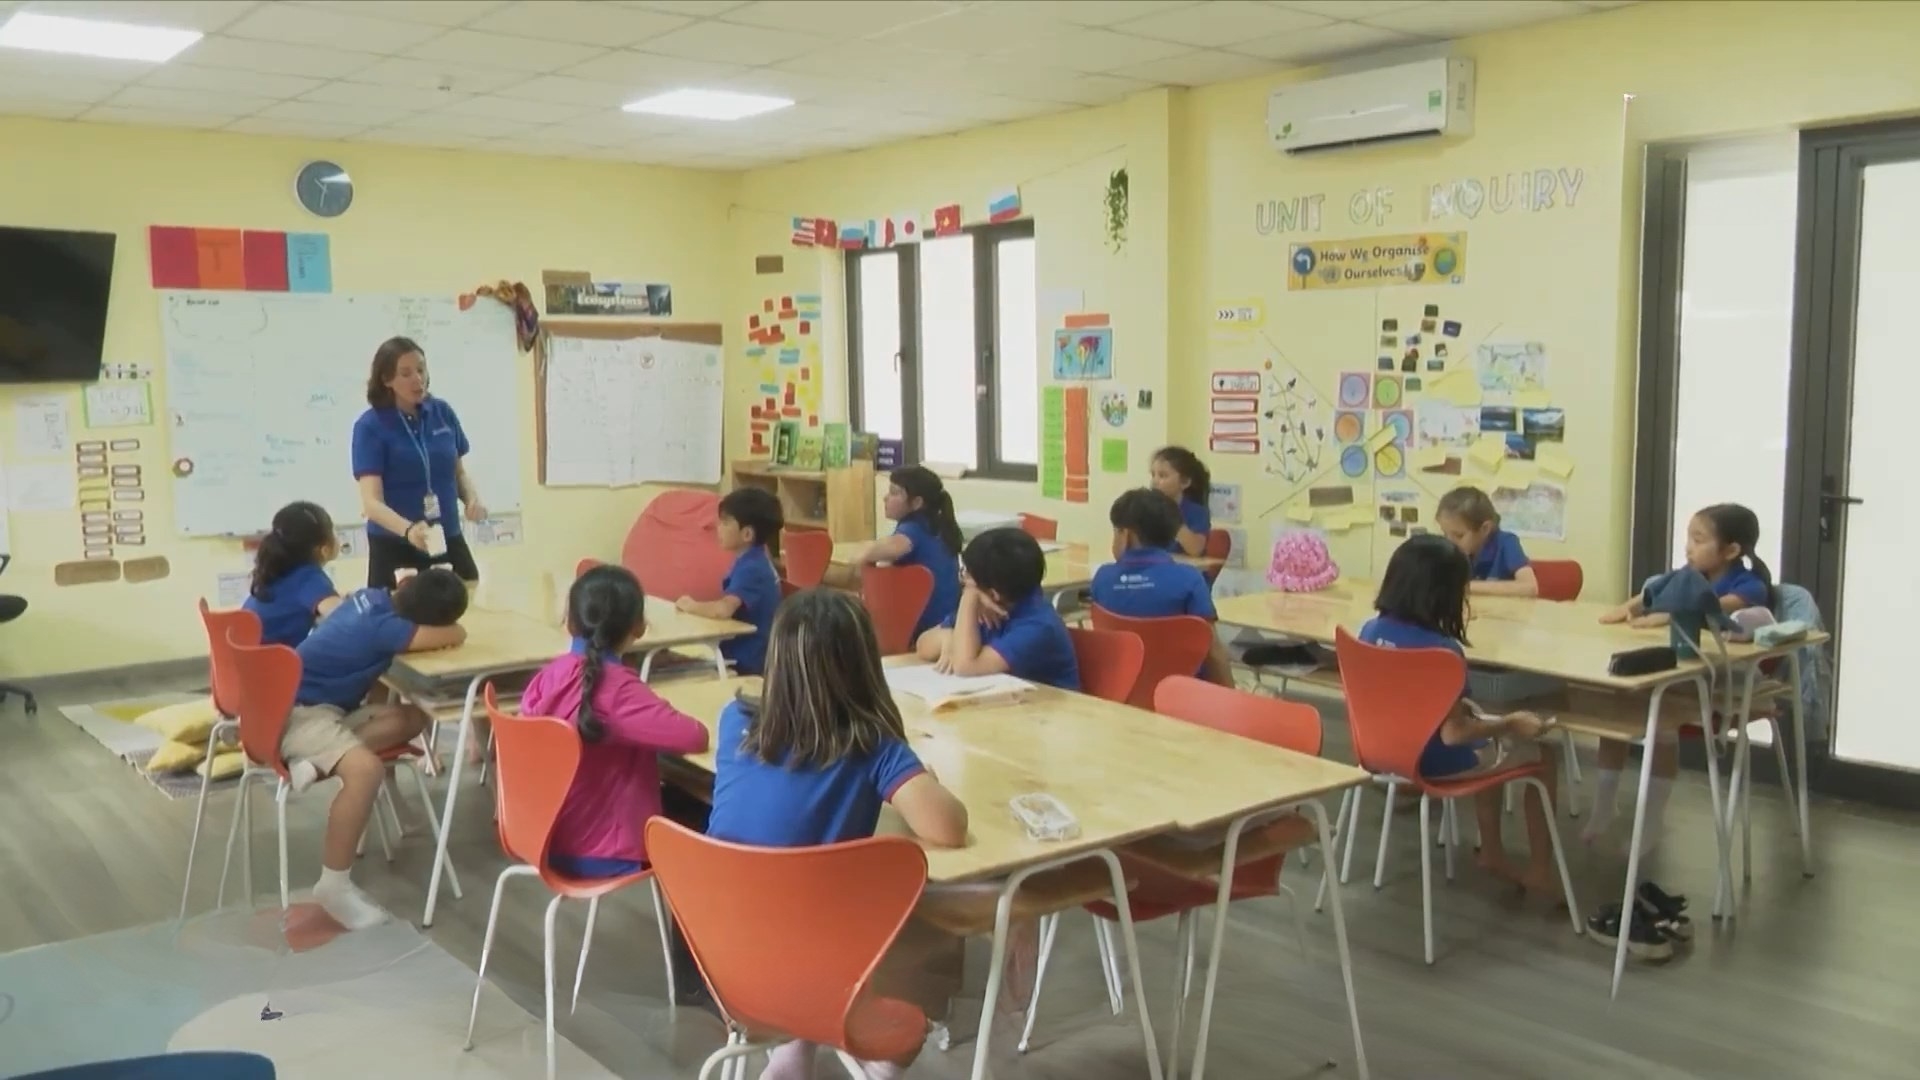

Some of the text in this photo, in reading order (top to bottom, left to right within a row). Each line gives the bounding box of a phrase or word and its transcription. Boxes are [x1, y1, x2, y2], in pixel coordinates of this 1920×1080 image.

[1255, 194, 1326, 236] UNIT
[1348, 186, 1394, 227] OF
[1320, 245, 1429, 262] How We Organise
[577, 291, 643, 309] Ecosystems
